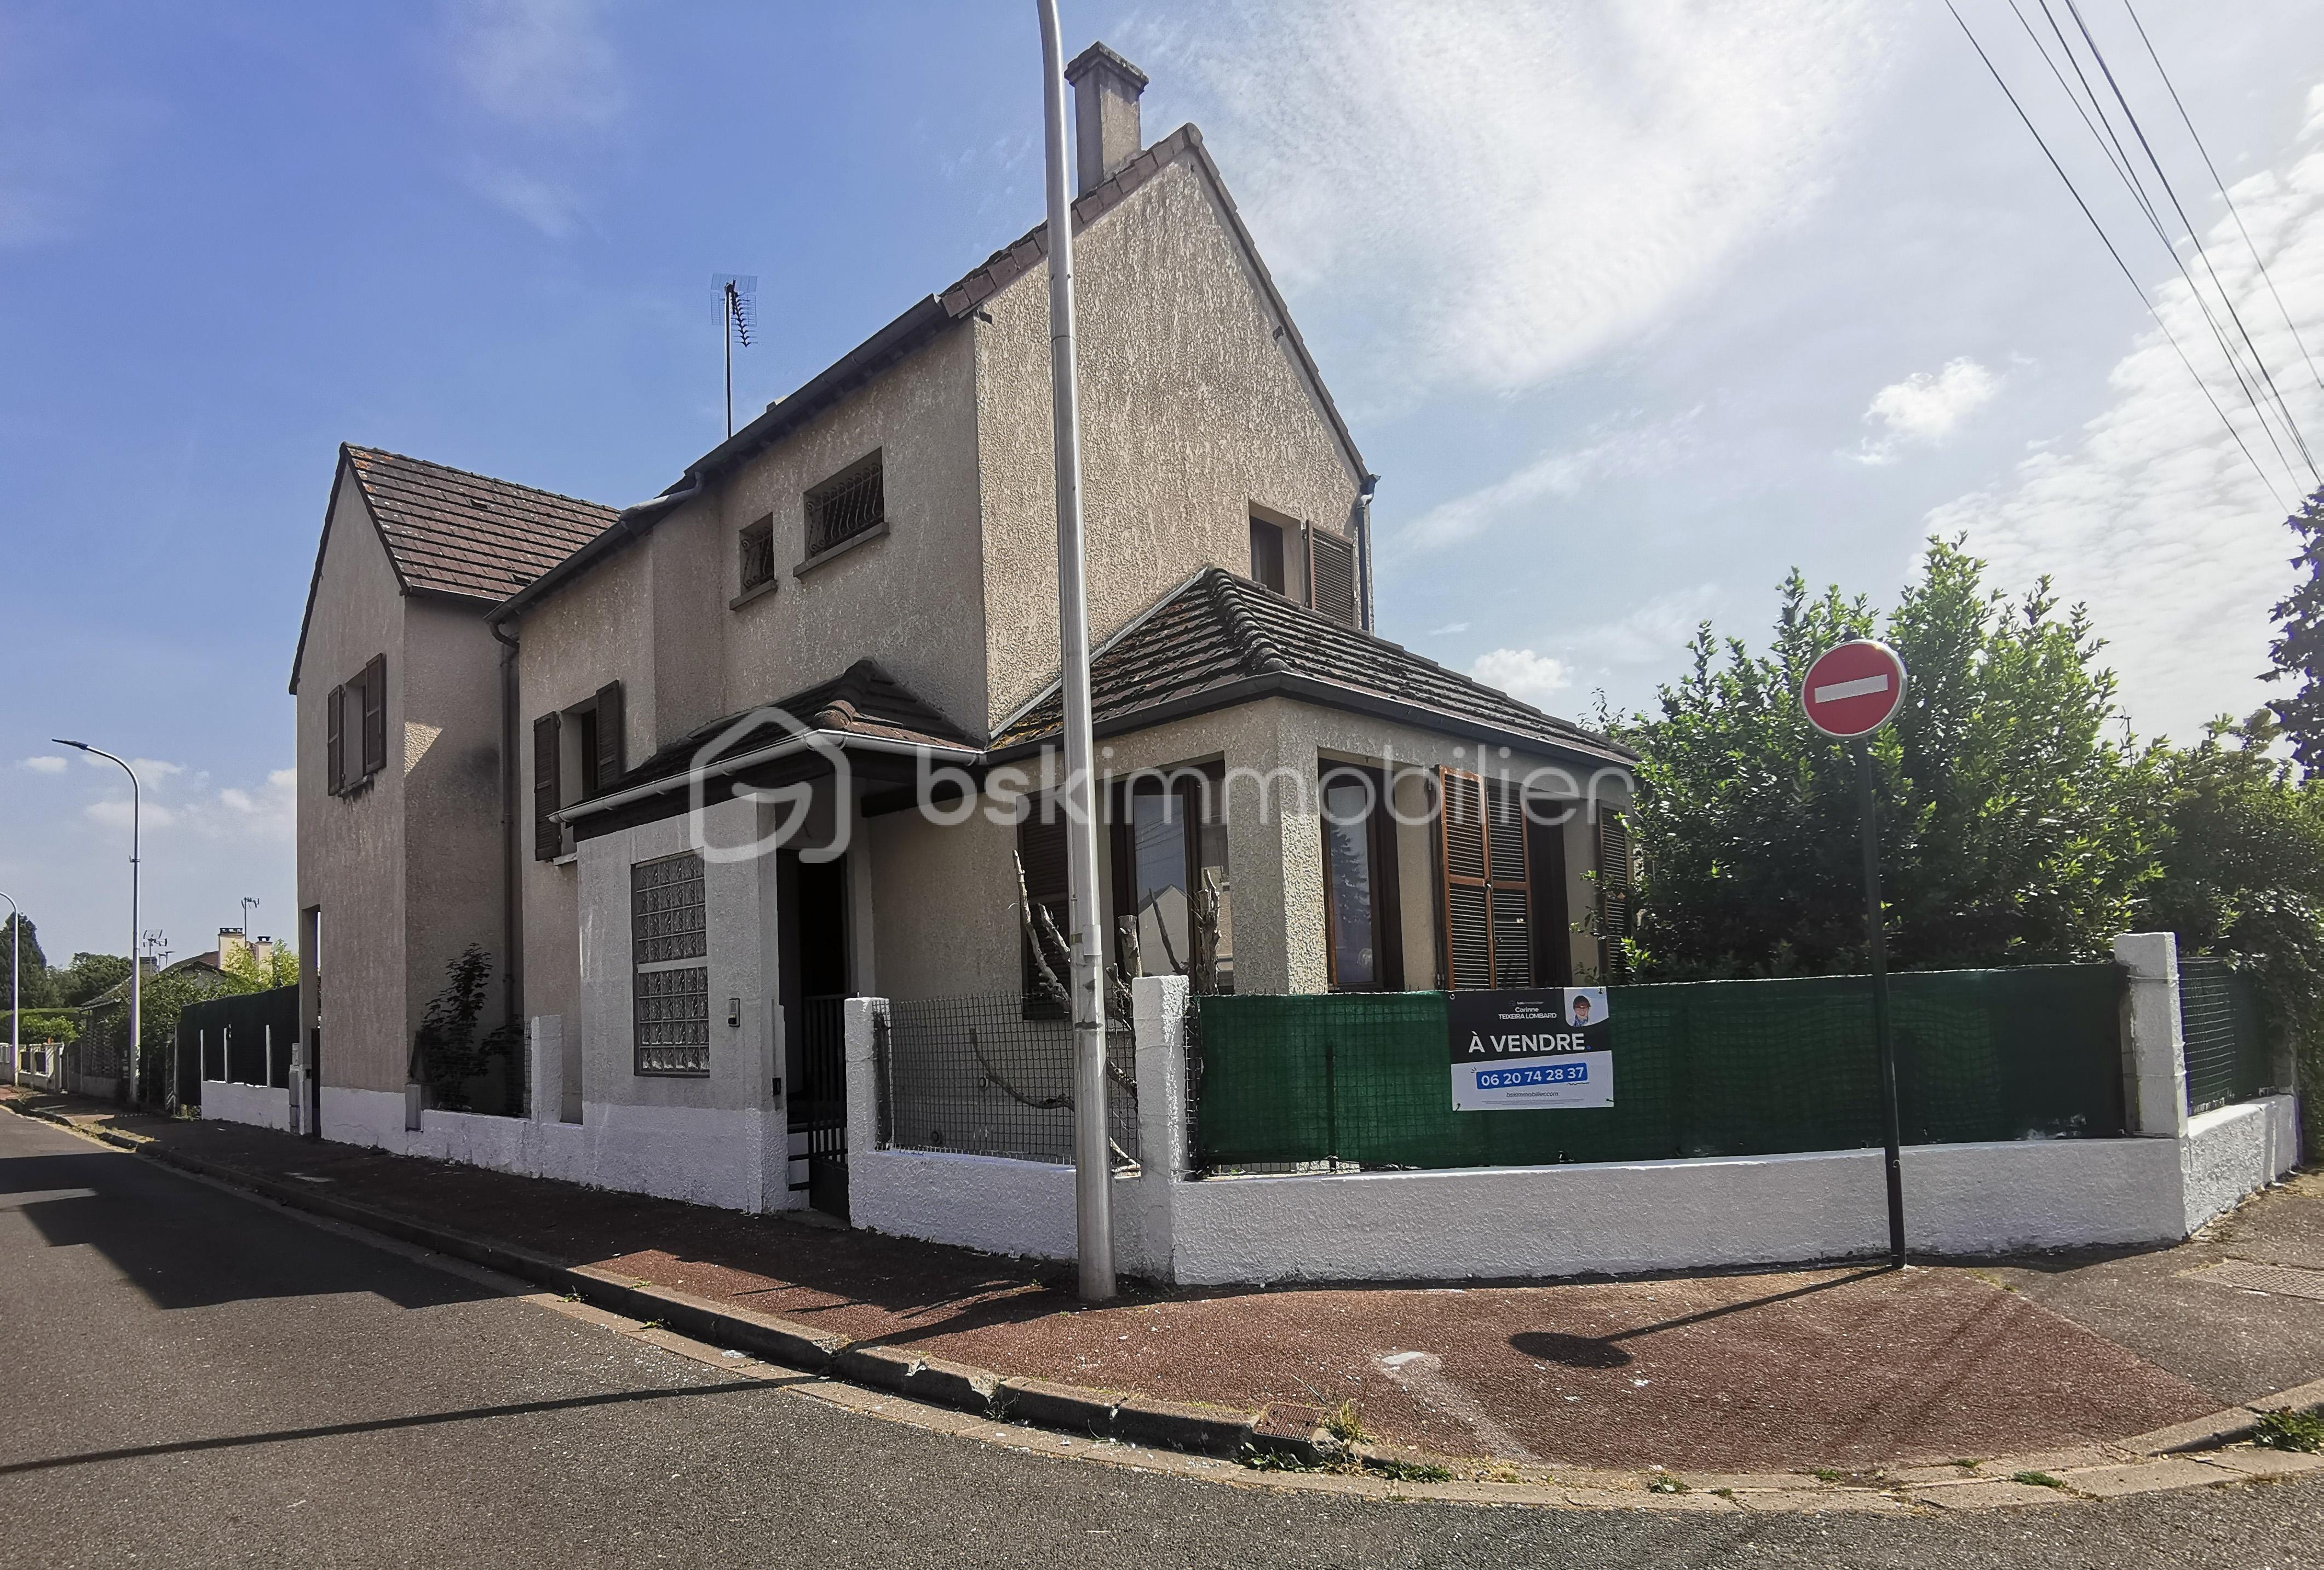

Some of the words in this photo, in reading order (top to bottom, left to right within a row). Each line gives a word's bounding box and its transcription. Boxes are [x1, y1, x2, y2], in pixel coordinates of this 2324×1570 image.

[1468, 1031, 1486, 1053] À
[1481, 1074, 1500, 1086] 06
[1503, 1072, 1521, 1084] 20
[1524, 1070, 1542, 1082] 74
[1545, 1068, 1564, 1081] 28
[1567, 1067, 1584, 1079] 37
